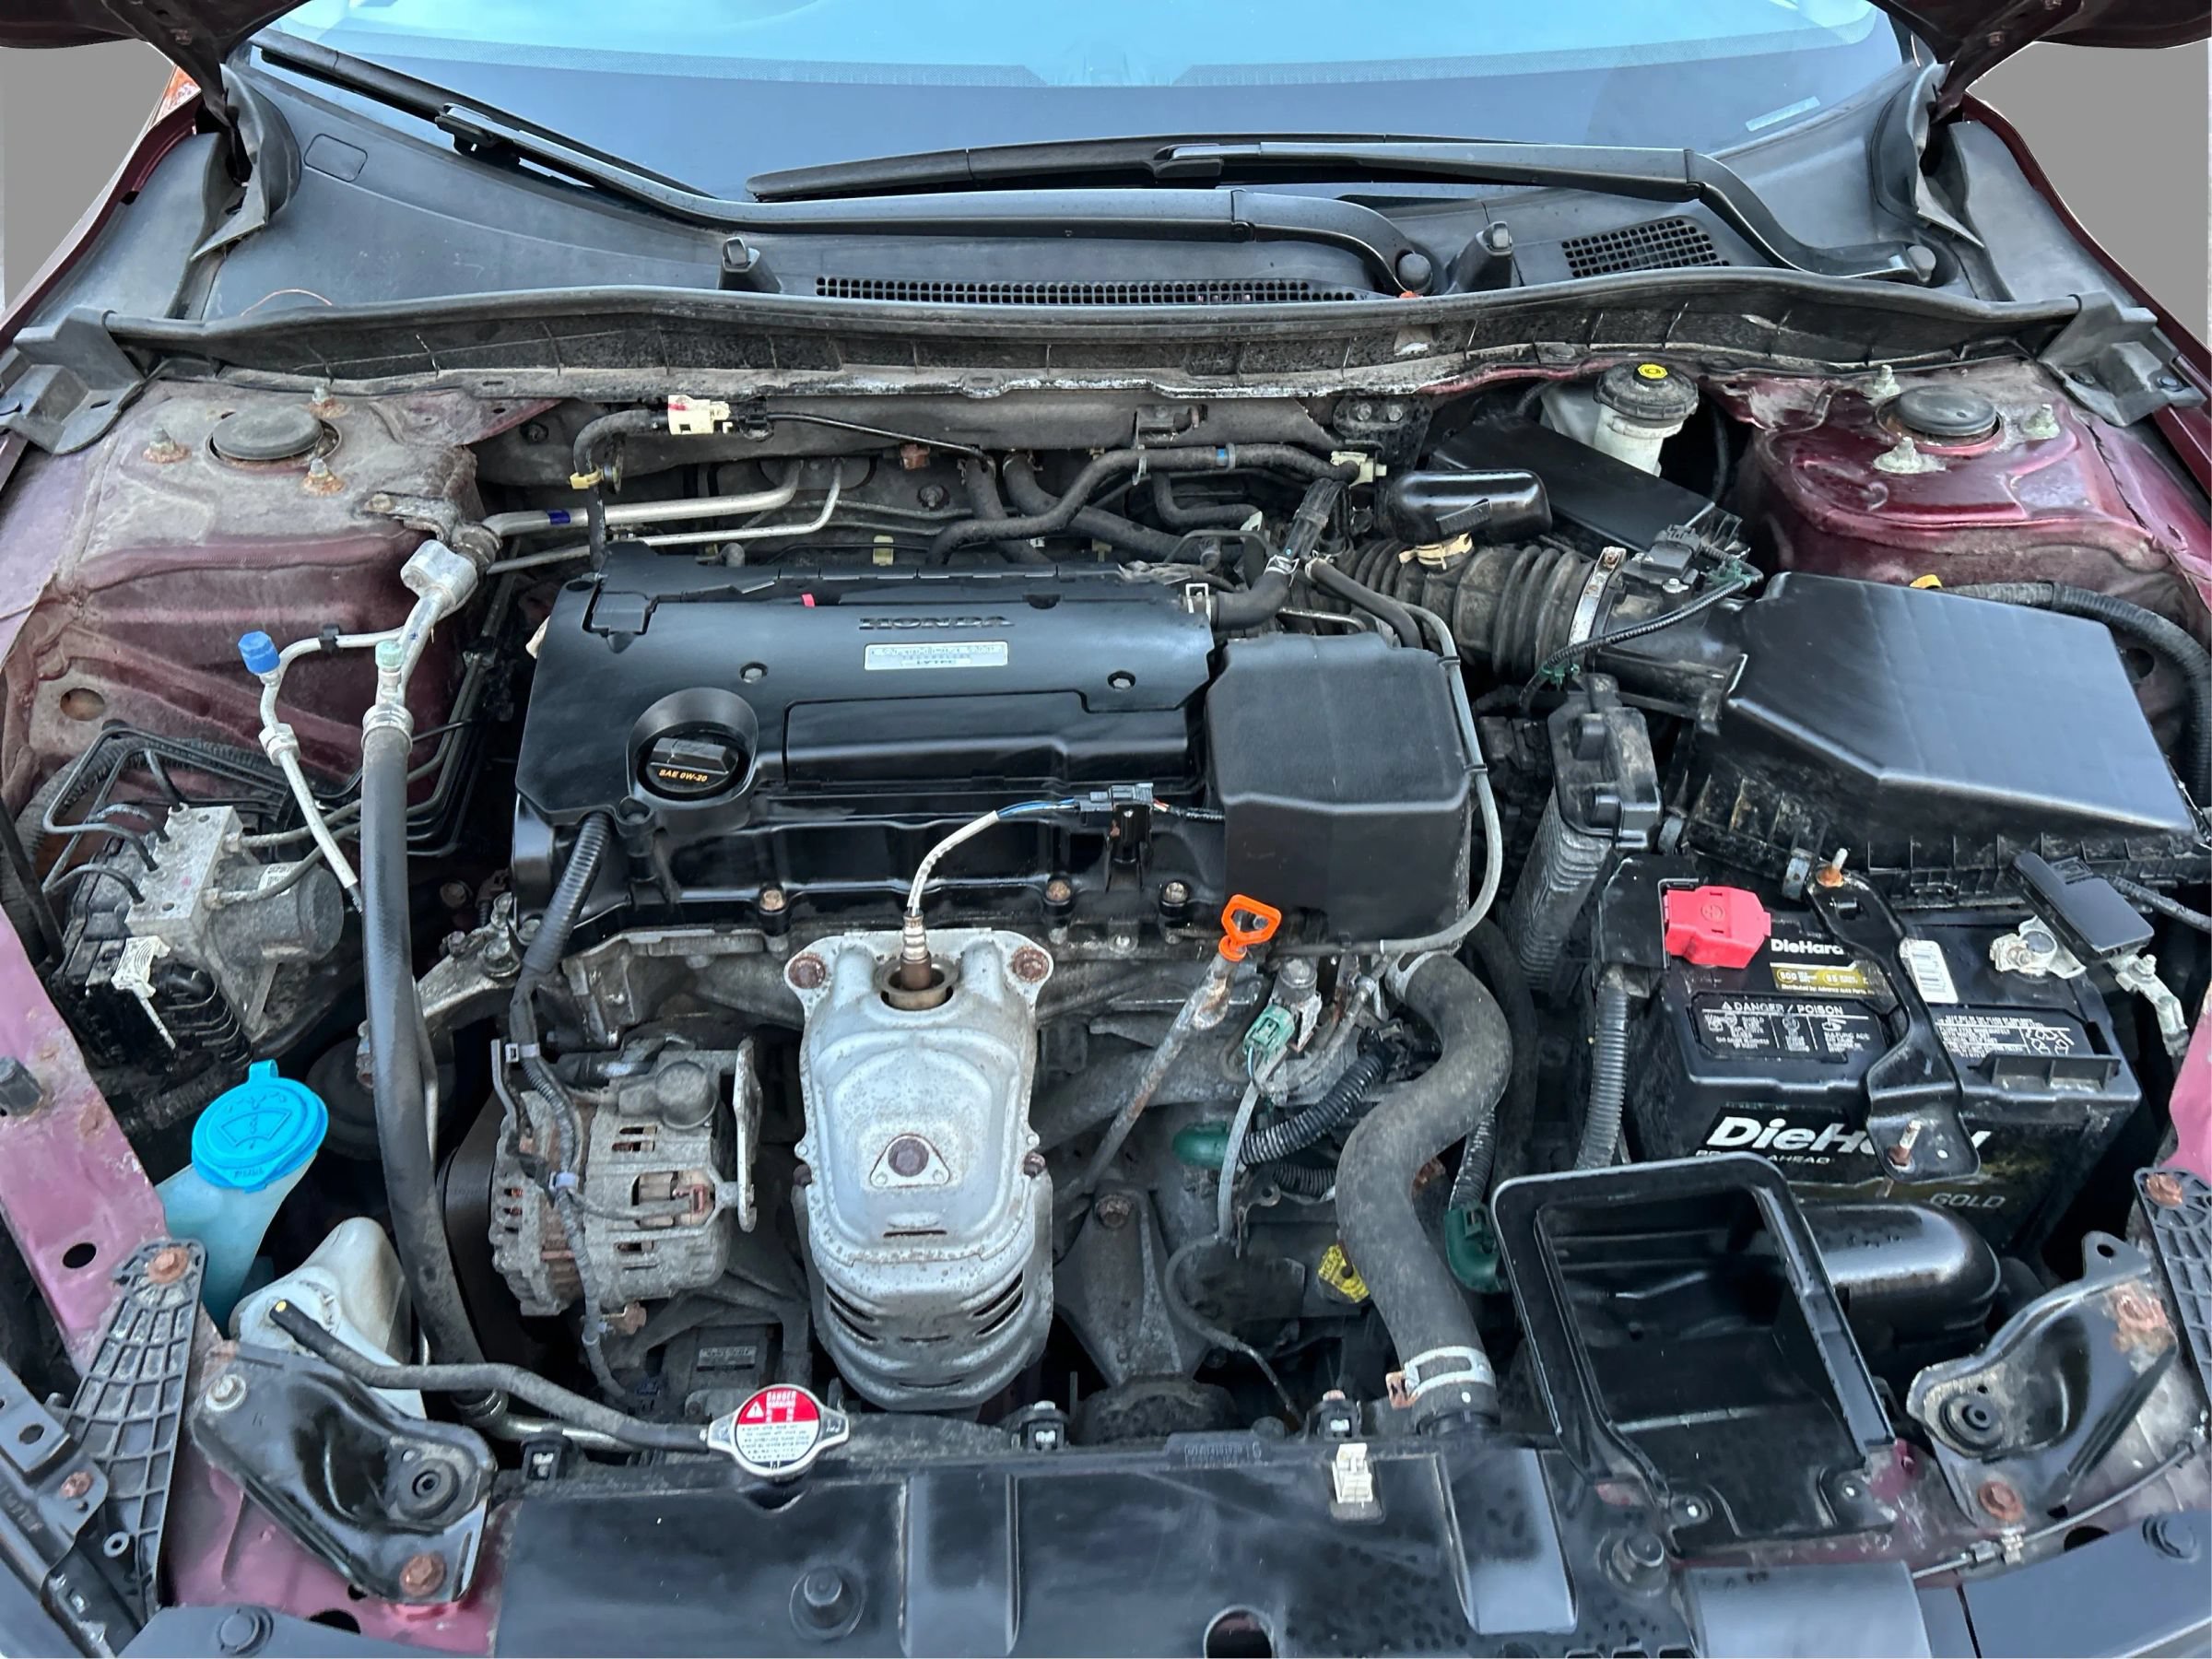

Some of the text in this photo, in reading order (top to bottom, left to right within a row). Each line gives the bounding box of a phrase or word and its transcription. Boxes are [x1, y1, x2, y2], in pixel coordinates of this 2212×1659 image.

[859, 616, 1015, 629] HONDA
[659, 769, 708, 782] SAE 0W-20
[1734, 1002, 1784, 1013] DANGER
[1796, 1004, 1842, 1016] POISON
[1930, 1193, 2006, 1208] GOLD
